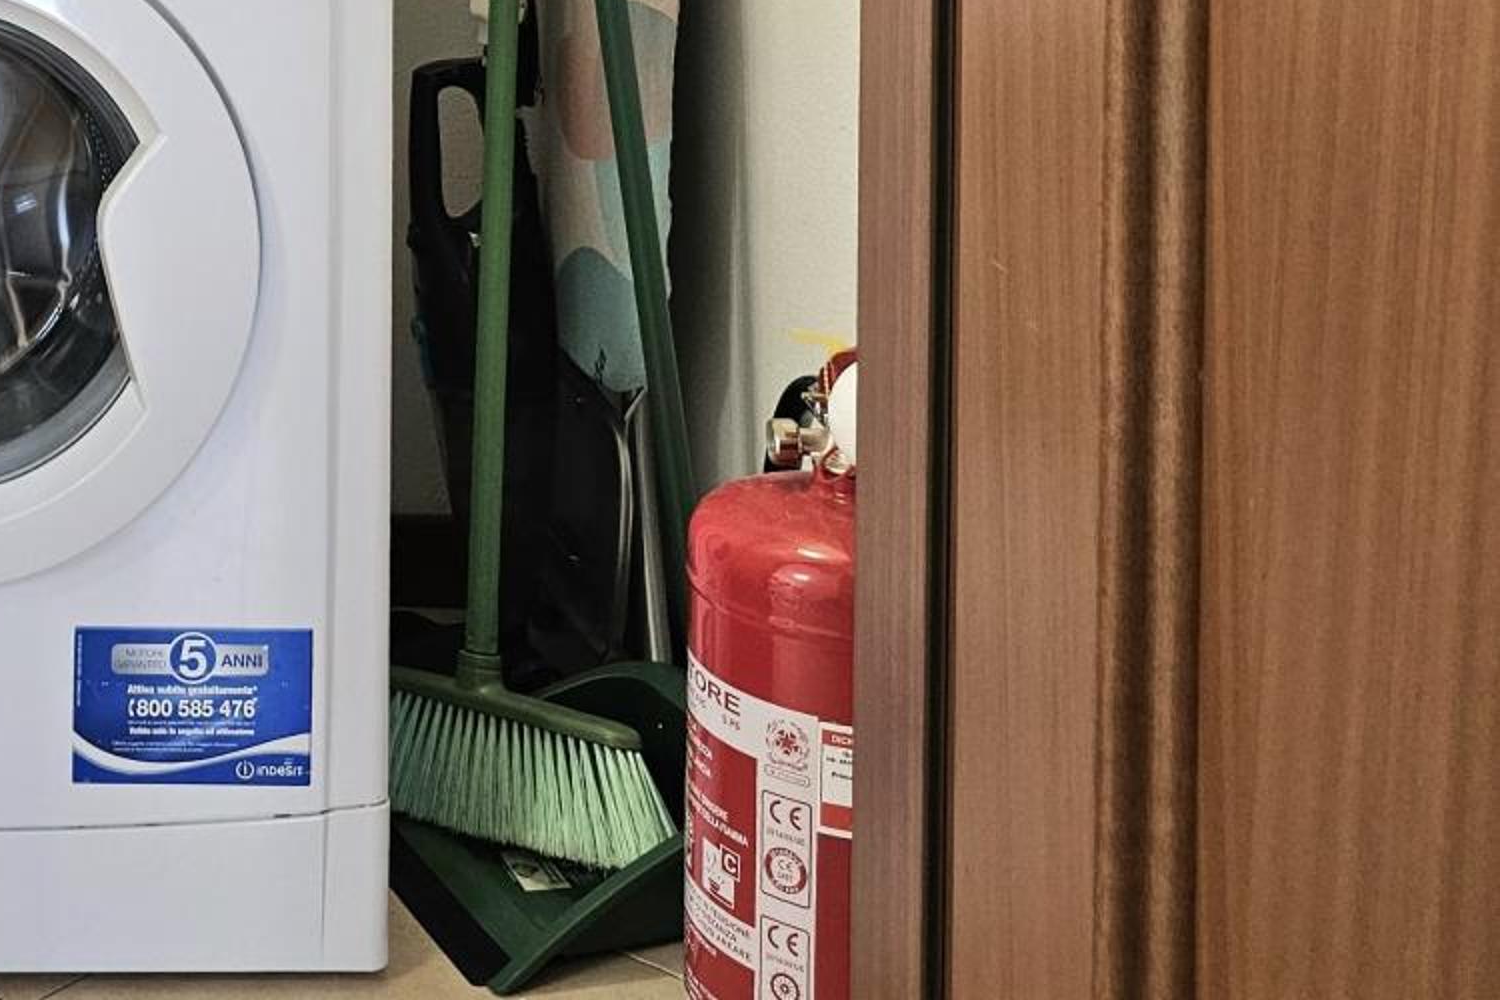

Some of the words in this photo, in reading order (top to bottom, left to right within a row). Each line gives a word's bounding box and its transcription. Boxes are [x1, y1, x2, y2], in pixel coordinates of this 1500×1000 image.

[179, 639, 207, 678] 5
[136, 699, 173, 718] 800
[177, 699, 214, 718] 585
[722, 853, 738, 875] C
